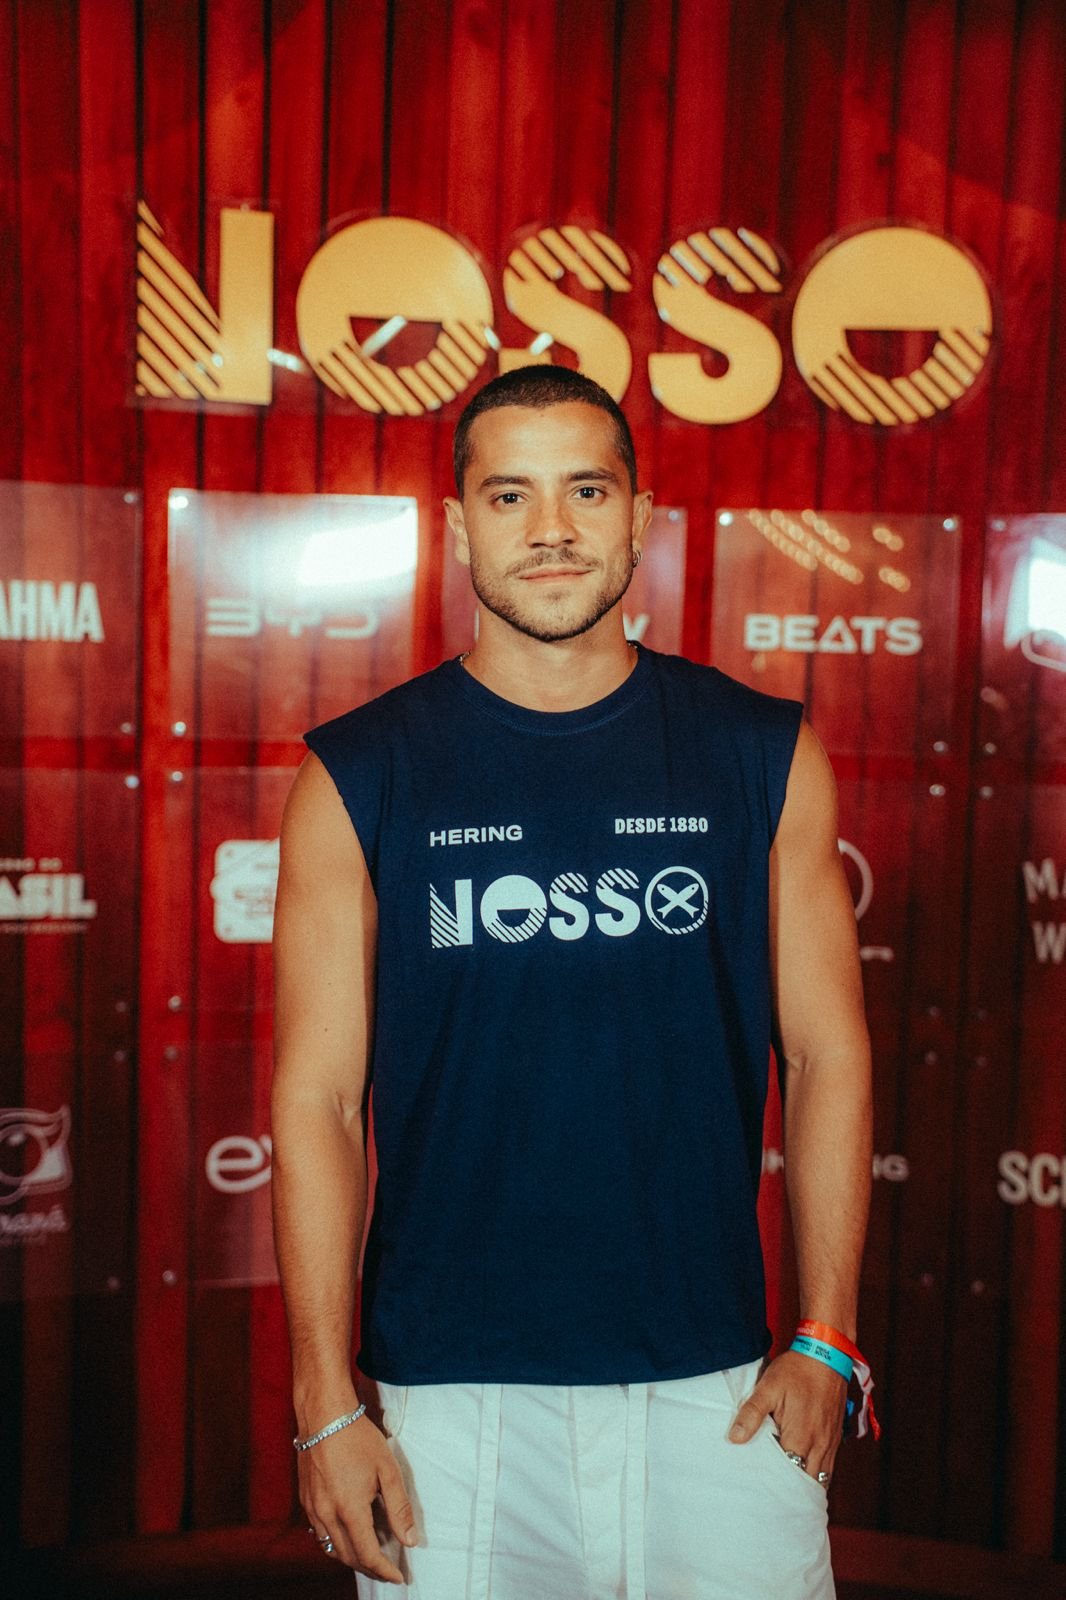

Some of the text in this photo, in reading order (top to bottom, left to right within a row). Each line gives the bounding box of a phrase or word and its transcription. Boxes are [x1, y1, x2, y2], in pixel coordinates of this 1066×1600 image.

[136, 200, 993, 426] NOSSO
[744, 613, 923, 656] BEATS
[429, 824, 523, 848] HERING
[614, 816, 709, 835] DESDE 1880
